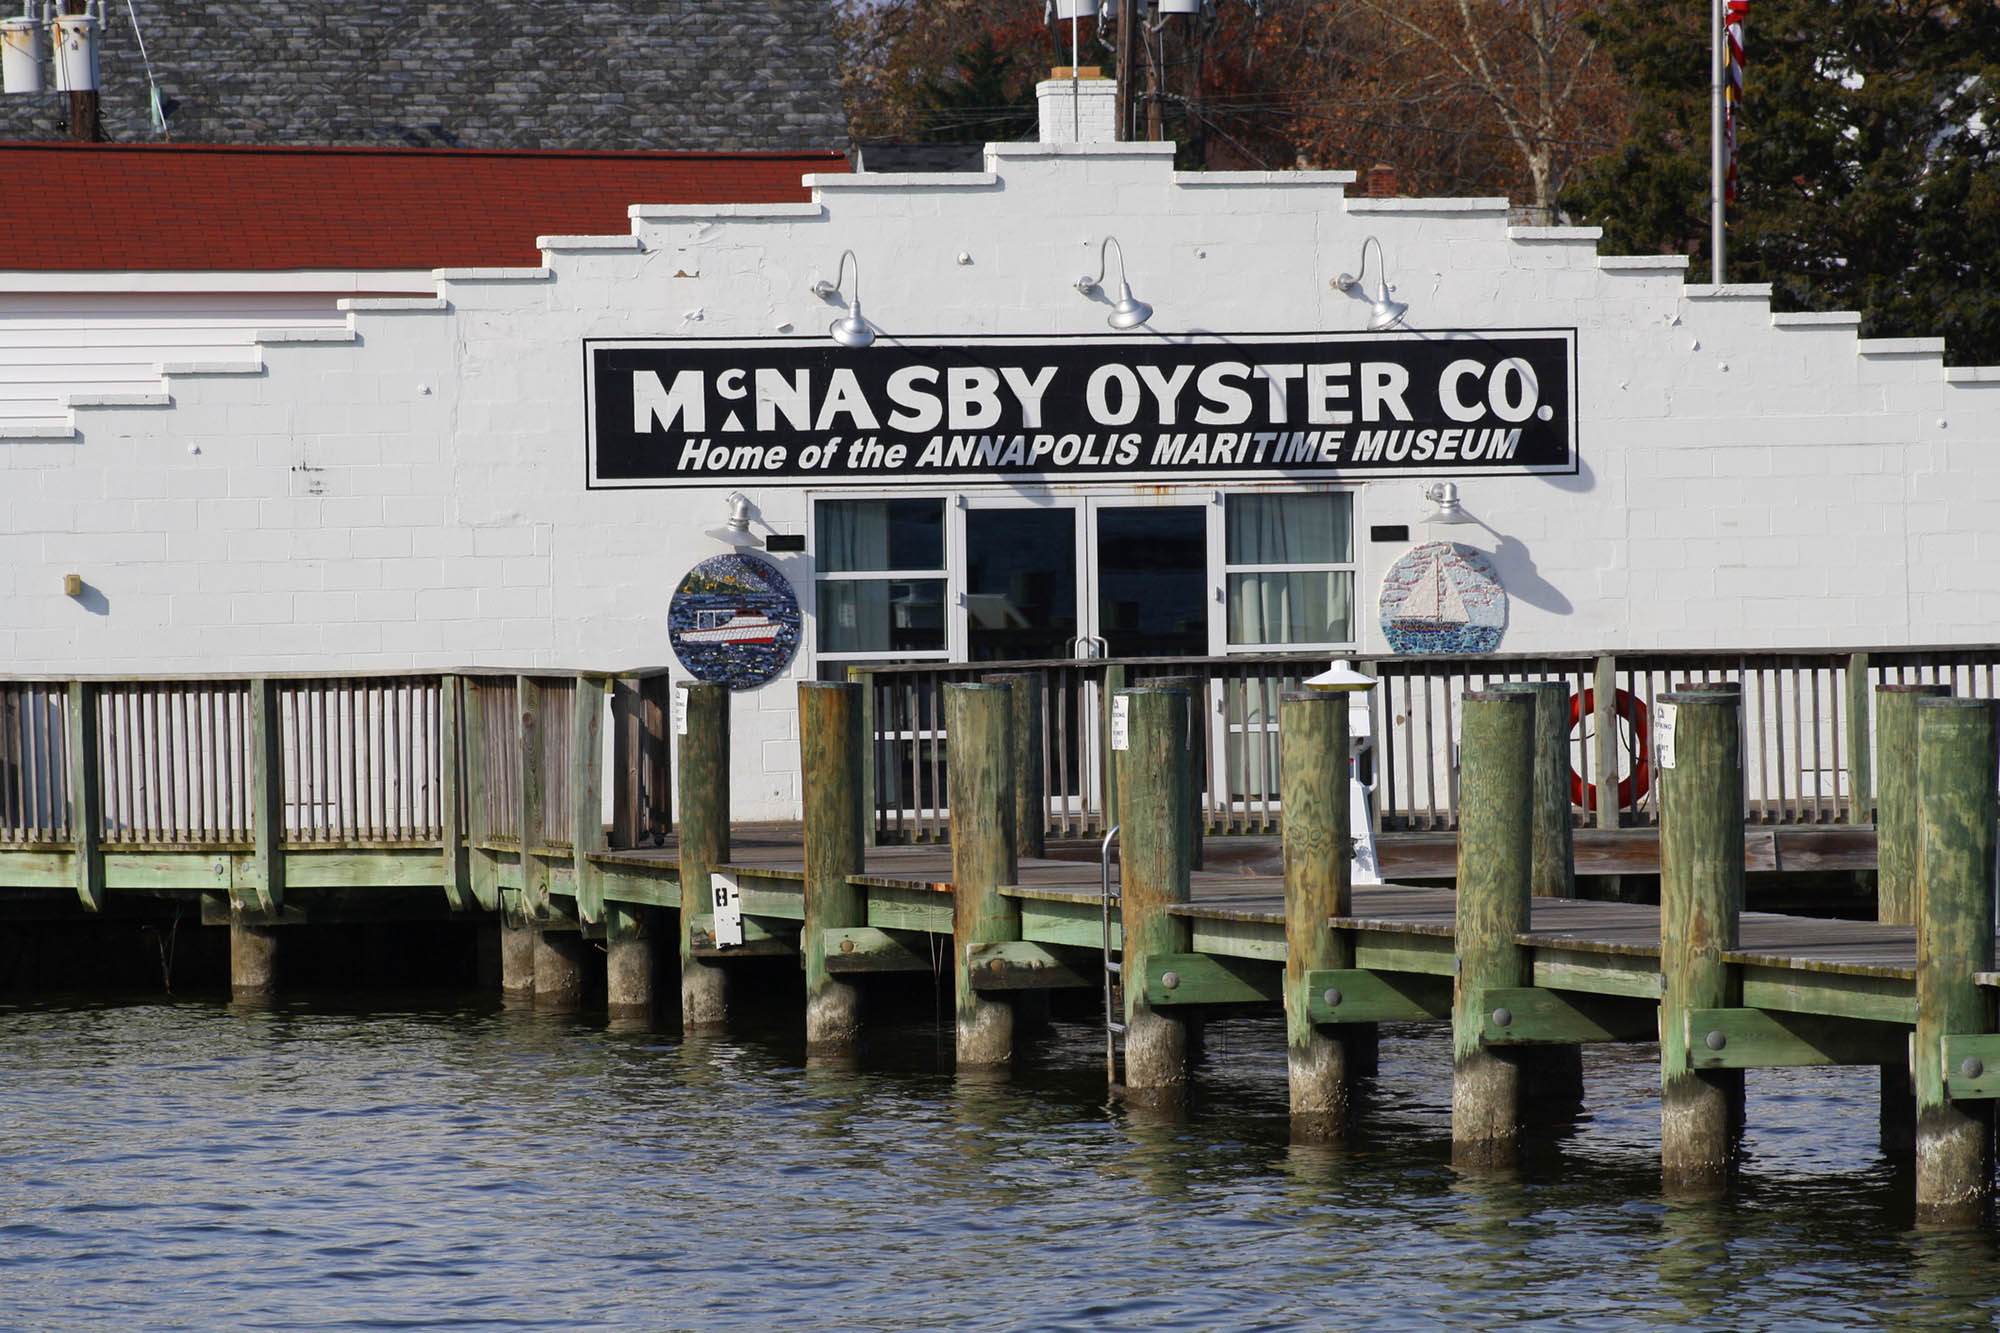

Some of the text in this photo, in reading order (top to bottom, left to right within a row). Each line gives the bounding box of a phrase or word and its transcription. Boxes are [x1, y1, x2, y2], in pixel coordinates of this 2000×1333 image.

[633, 358, 1554, 434] McNASBY OYSTER CO.
[677, 428, 1523, 471] Home of the ANNAPOLIS MARITIME MUSEUM
